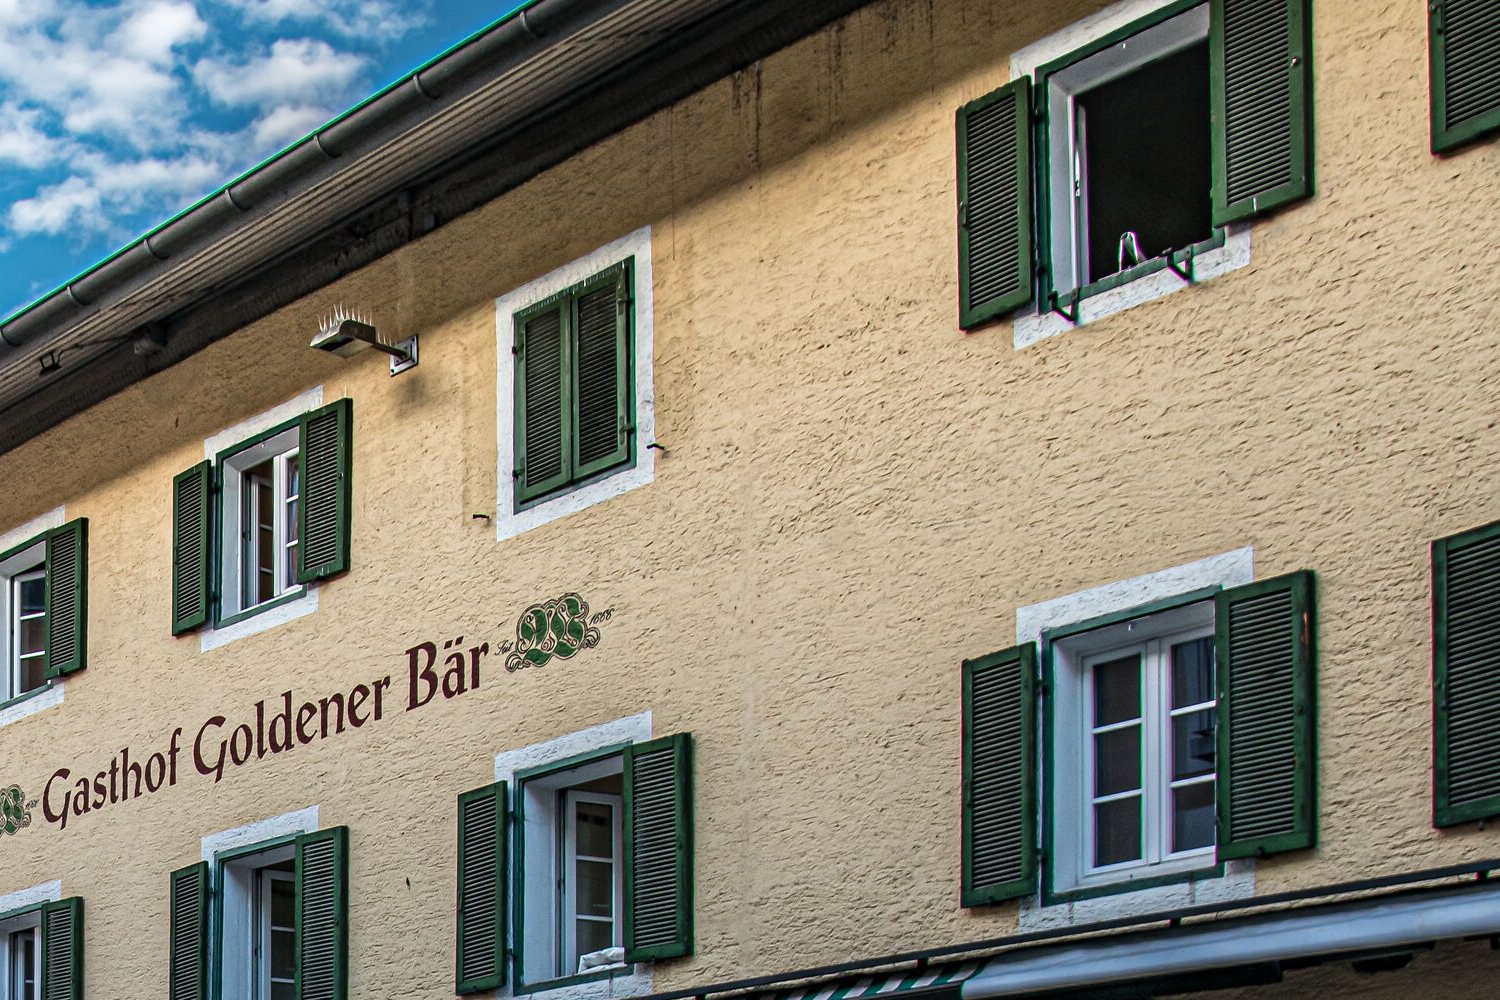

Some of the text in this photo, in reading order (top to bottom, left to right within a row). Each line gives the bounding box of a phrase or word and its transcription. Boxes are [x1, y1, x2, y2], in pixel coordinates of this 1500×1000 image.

[42, 635, 490, 831] Gasthof Goldener Bär
